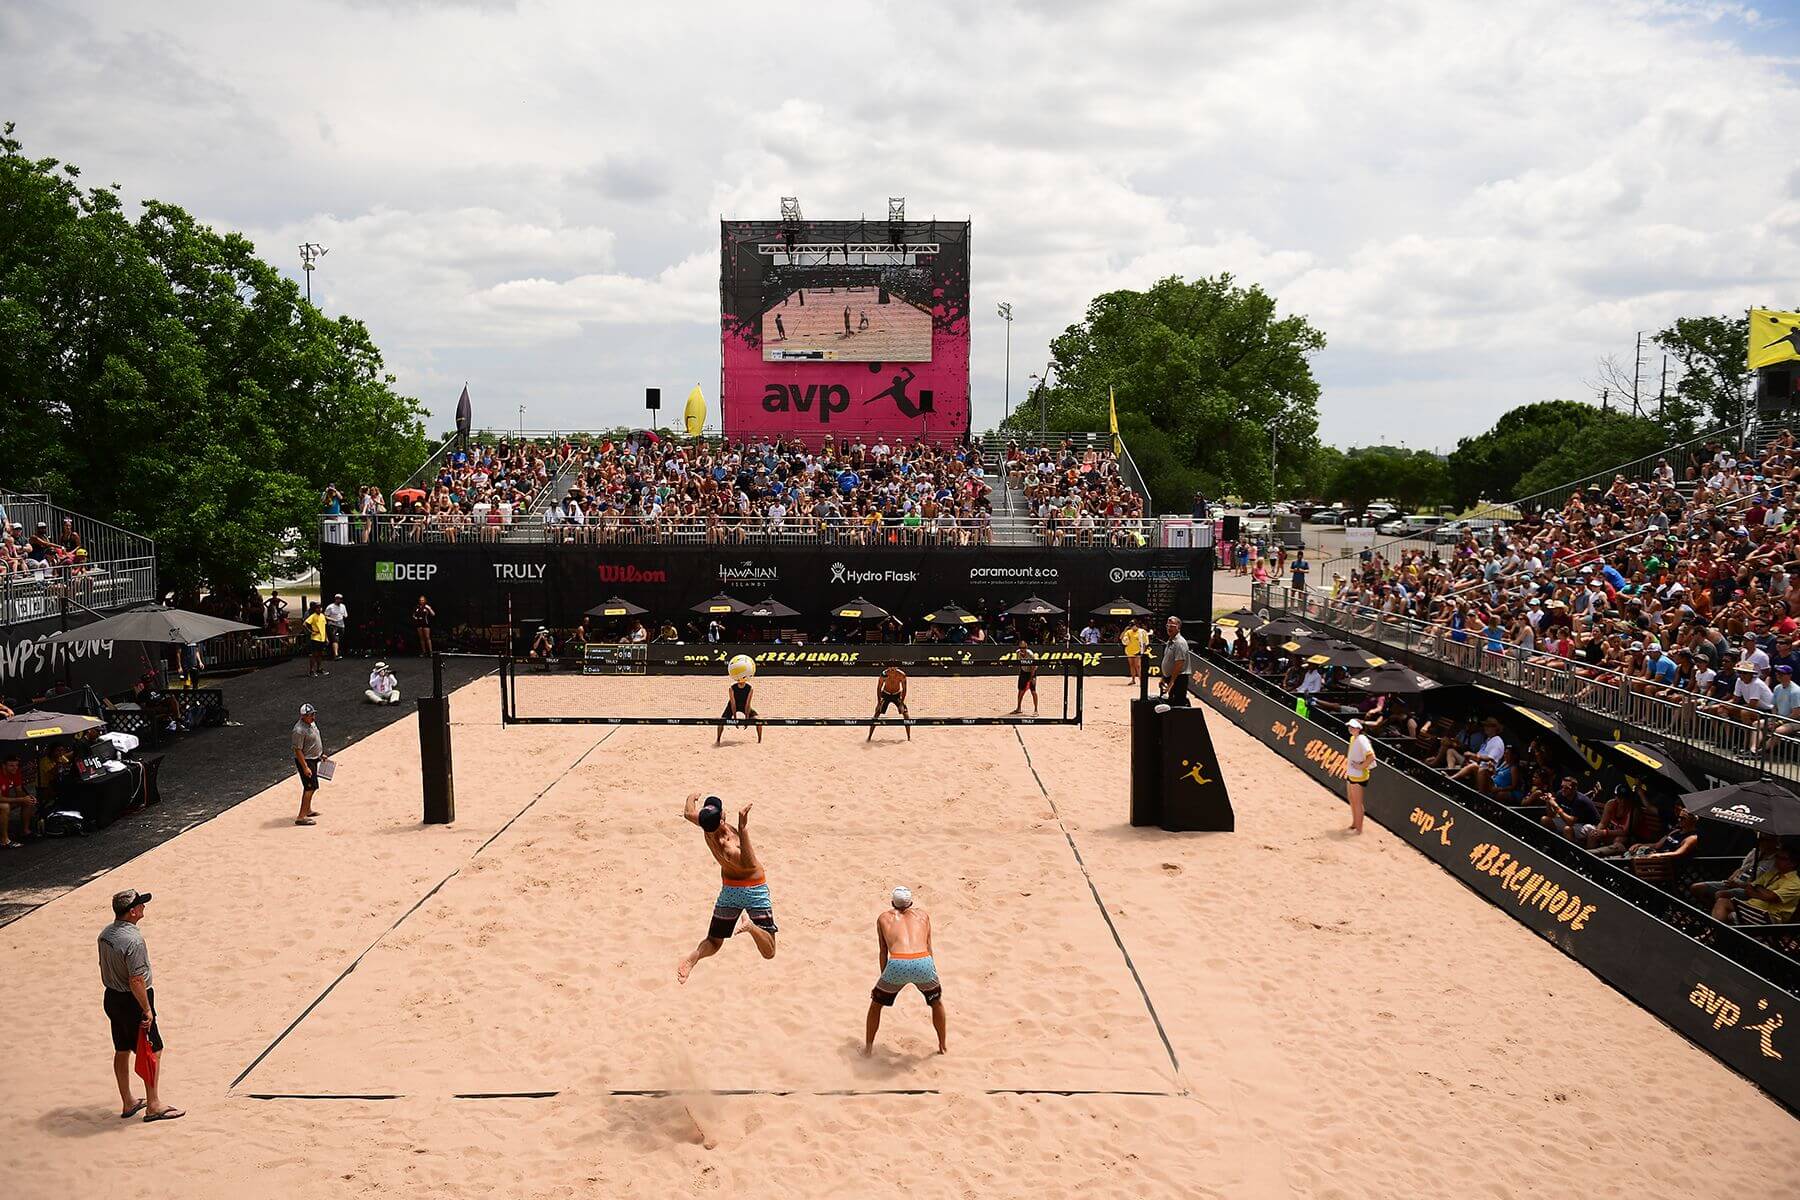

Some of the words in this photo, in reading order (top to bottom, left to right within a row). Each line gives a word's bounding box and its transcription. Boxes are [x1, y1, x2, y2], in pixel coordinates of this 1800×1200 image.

[762, 384, 849, 423] avp
[395, 564, 437, 580] DEEP
[493, 563, 546, 578] TRULY
[599, 565, 666, 582] Wilson
[719, 564, 776, 583] HAWAIIAN
[847, 570, 882, 584] Hydro
[885, 570, 917, 582] Flask
[1409, 807, 1435, 835] avp
[1469, 842, 1598, 931] #BEACHMODE
[1689, 982, 1741, 1030] avp
